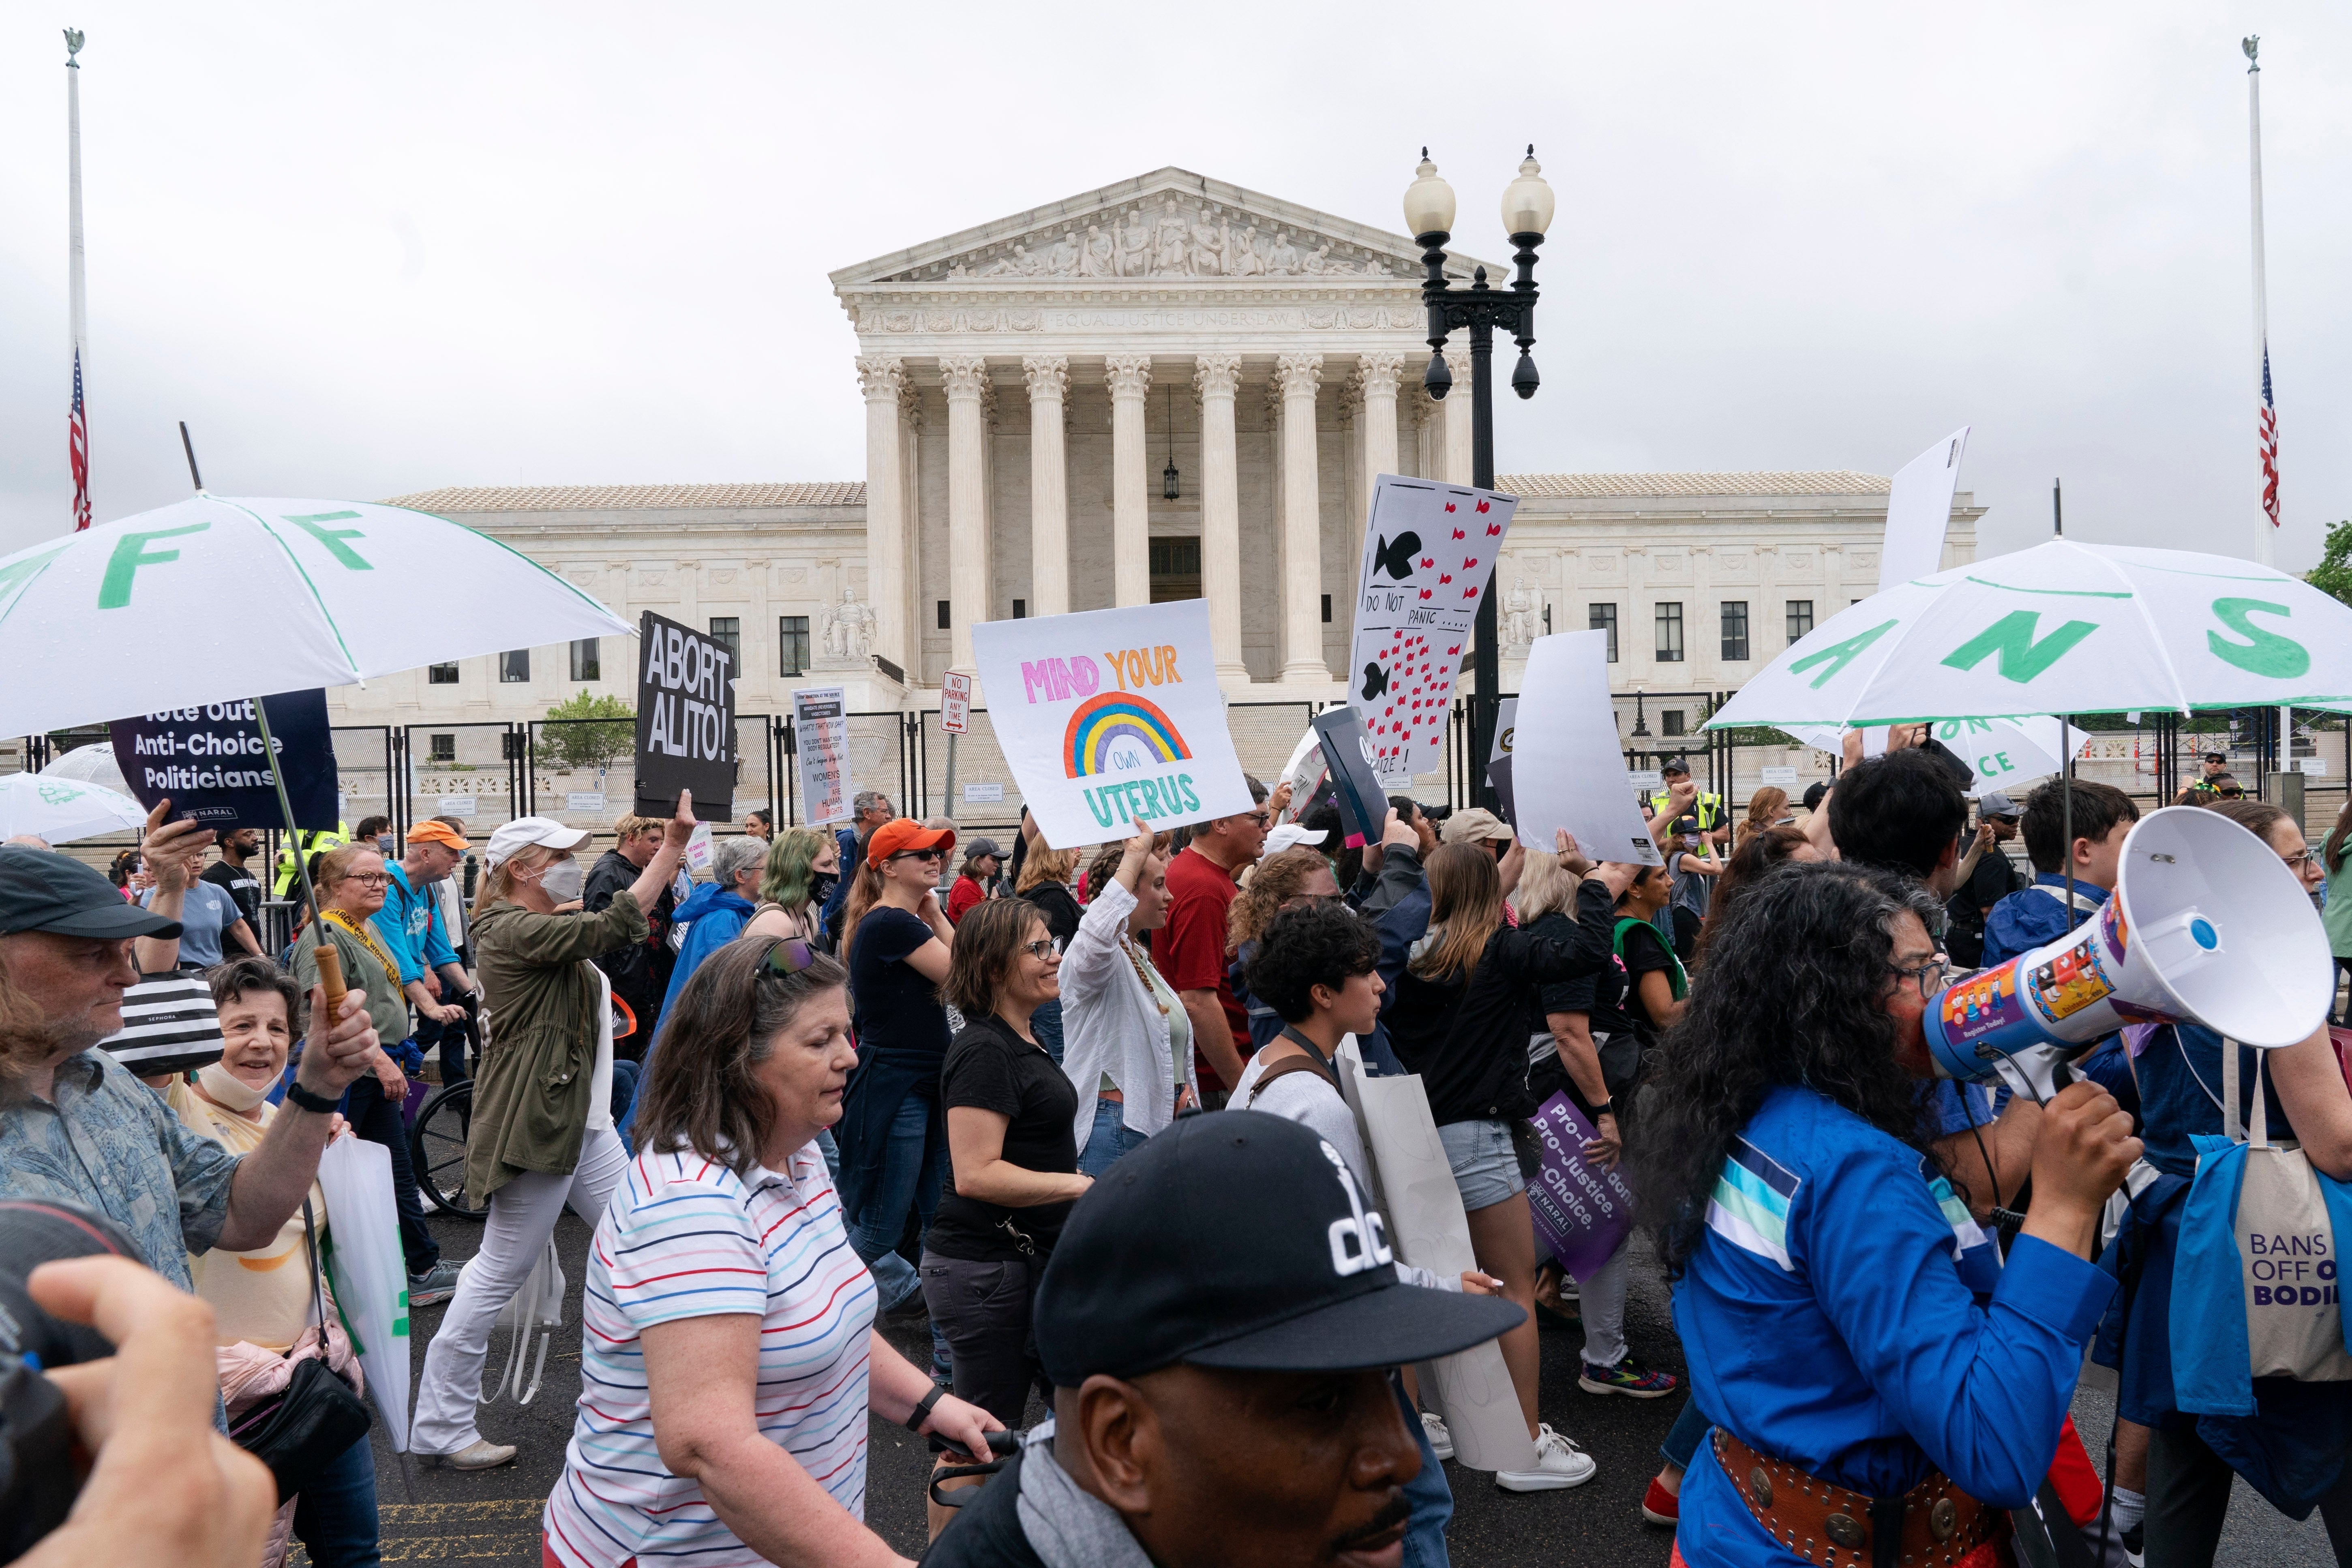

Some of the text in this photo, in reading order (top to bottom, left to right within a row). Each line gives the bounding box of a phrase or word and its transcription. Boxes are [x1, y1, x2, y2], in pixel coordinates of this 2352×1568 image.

[1056, 312, 1290, 326] EQUAL JUSTICE UNDER LAW
[1367, 592, 1404, 612] DO NOT
[1408, 610, 1436, 625] PANIC
[646, 623, 729, 707] ABORT
[1021, 645, 1182, 704] MIND YOUR
[951, 677, 962, 689] NO
[945, 688, 968, 702] PARKING
[207, 699, 257, 721] Out
[949, 702, 961, 711] ANY
[949, 711, 961, 721] TIME
[648, 692, 727, 762] ALITO!
[800, 724, 814, 732] WHAT'S
[135, 731, 283, 755] Anti-Choice
[806, 756, 815, 766] Can't
[816, 755, 827, 766] Imagine
[1113, 750, 1141, 770] OWN
[1377, 757, 1396, 773] IZE
[145, 765, 277, 789] Politicians
[812, 770, 840, 782] WOMEN'S
[823, 780, 841, 789] RIGHTS
[832, 788, 841, 796] ARE
[1083, 773, 1201, 828] UTERUS
[822, 797, 842, 808] HUMAN
[826, 806, 843, 816] RIGHTS
[354, 927, 368, 942] FOR
[370, 942, 396, 975] WOMEN'S
[1963, 1016, 2006, 1038] Register Today!
[1534, 1117, 1613, 1218] Pro-Justice.
[1540, 1196, 1569, 1230] NARAL
[2251, 1234, 2327, 1255] BANS
[2252, 1260, 2309, 1281] OFF
